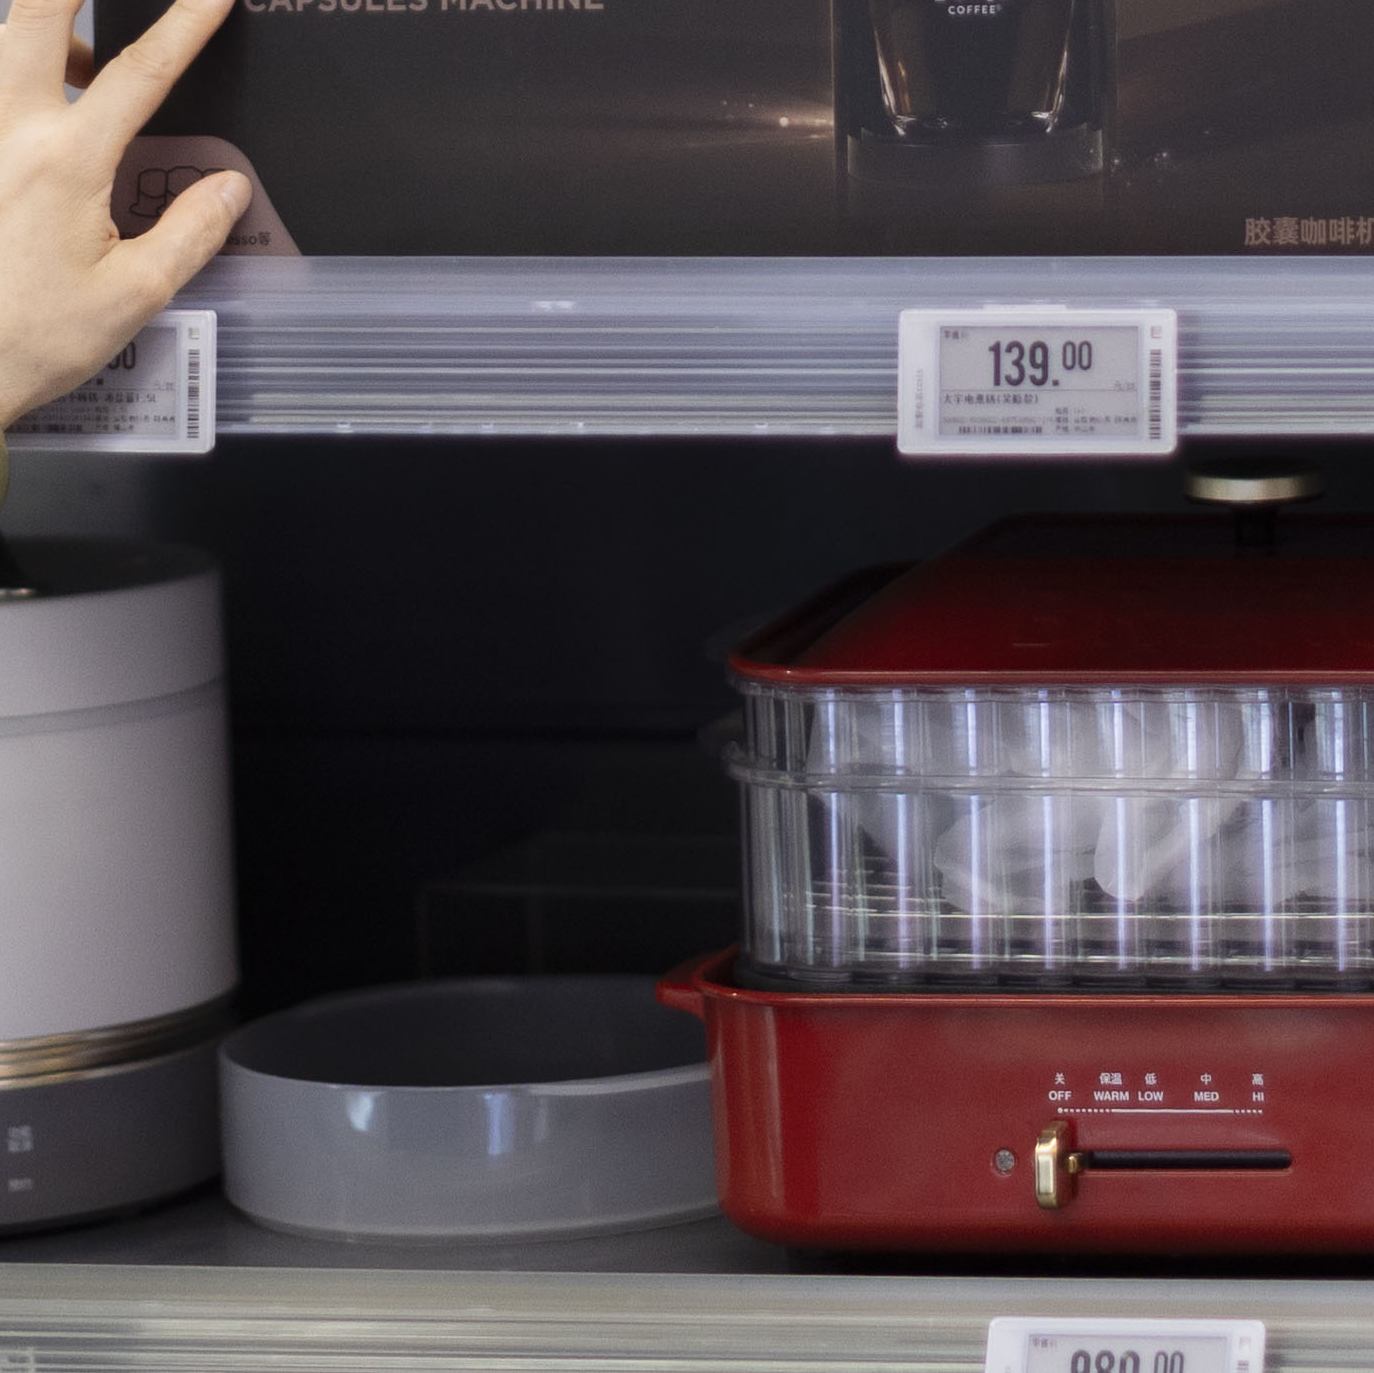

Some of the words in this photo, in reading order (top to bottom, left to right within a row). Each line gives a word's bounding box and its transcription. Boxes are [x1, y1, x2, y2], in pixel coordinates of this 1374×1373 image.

[948, 5, 996, 15] COFFEE
[1054, 1072, 1065, 1085] 关
[1099, 1072, 1122, 1085] 保温
[1145, 1072, 1156, 1085] 低
[1200, 1072, 1212, 1085] 中
[1252, 1072, 1264, 1085] 高
[1048, 1091, 1072, 1101] OFF
[1094, 1091, 1129, 1102] WARM
[1138, 1091, 1163, 1101] LOW
[1194, 1091, 1219, 1101] MED
[1252, 1091, 1264, 1101] HI
